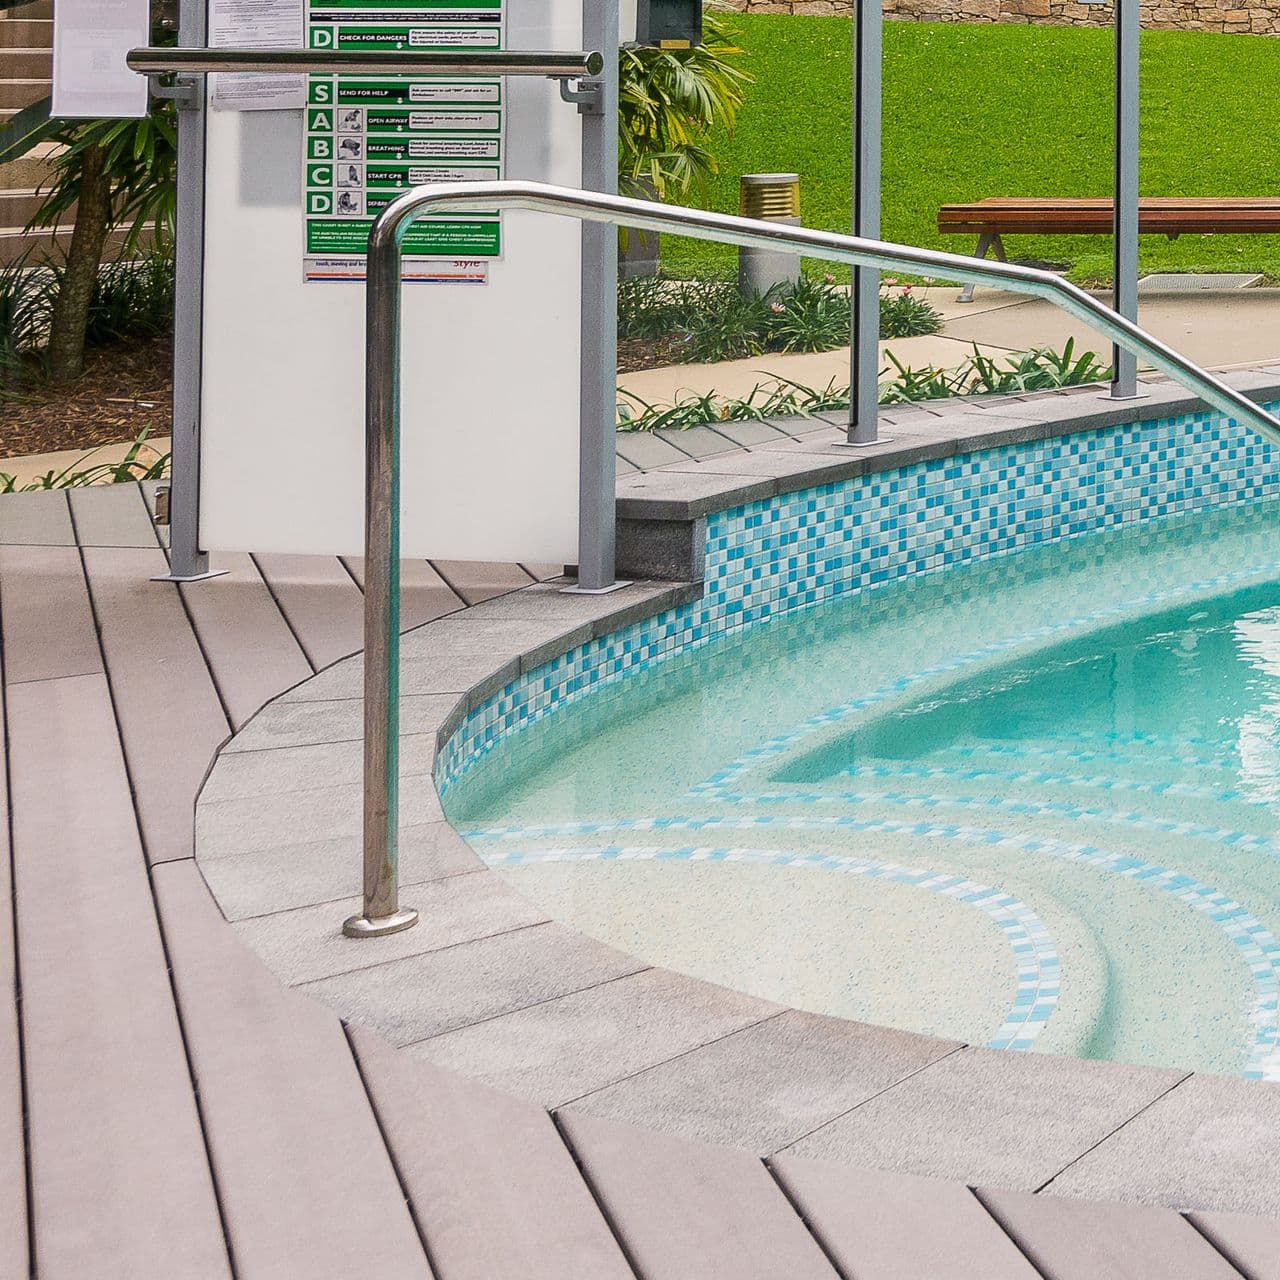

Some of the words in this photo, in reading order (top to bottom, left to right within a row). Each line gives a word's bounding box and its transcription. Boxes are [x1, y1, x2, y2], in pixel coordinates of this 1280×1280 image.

[313, 30, 332, 47] D
[314, 85, 329, 102] S
[311, 112, 331, 130] A
[313, 140, 330, 157] B
[312, 167, 330, 185] C
[311, 195, 330, 213] D
